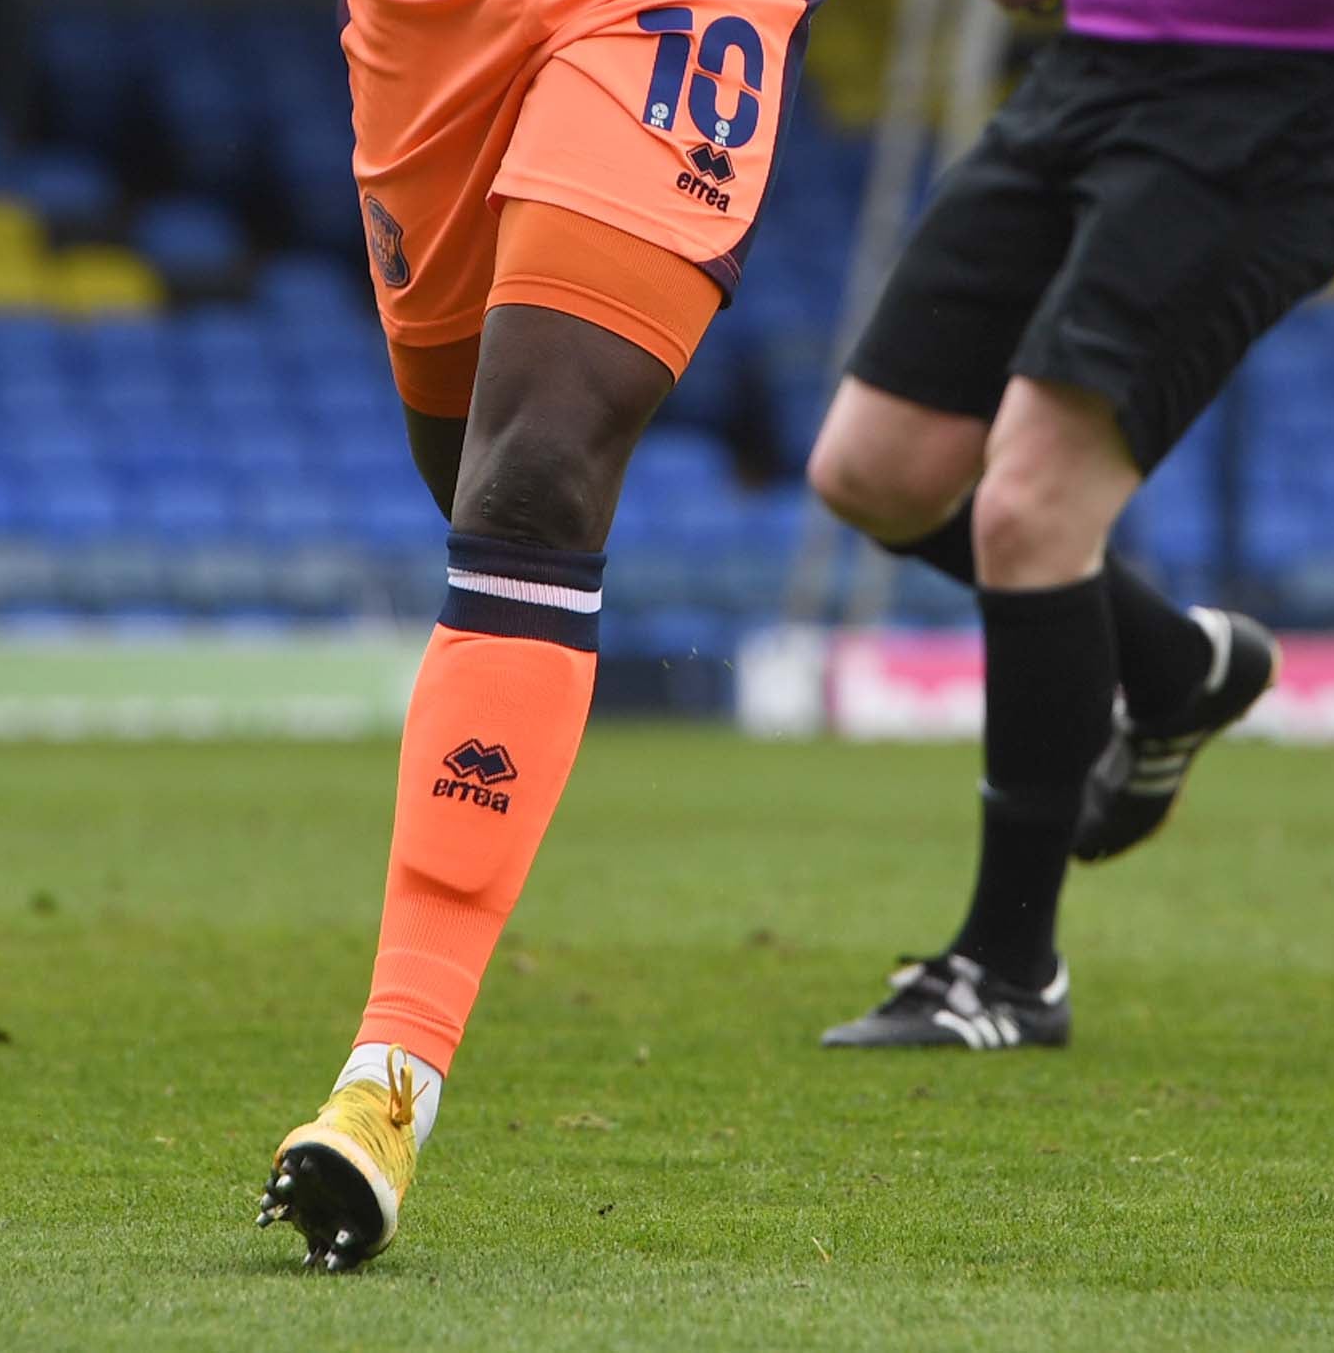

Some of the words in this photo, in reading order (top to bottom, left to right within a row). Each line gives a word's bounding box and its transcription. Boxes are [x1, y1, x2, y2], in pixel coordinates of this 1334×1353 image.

[637, 7, 765, 148] 10
[676, 170, 732, 213] errea
[433, 777, 511, 815] errea
